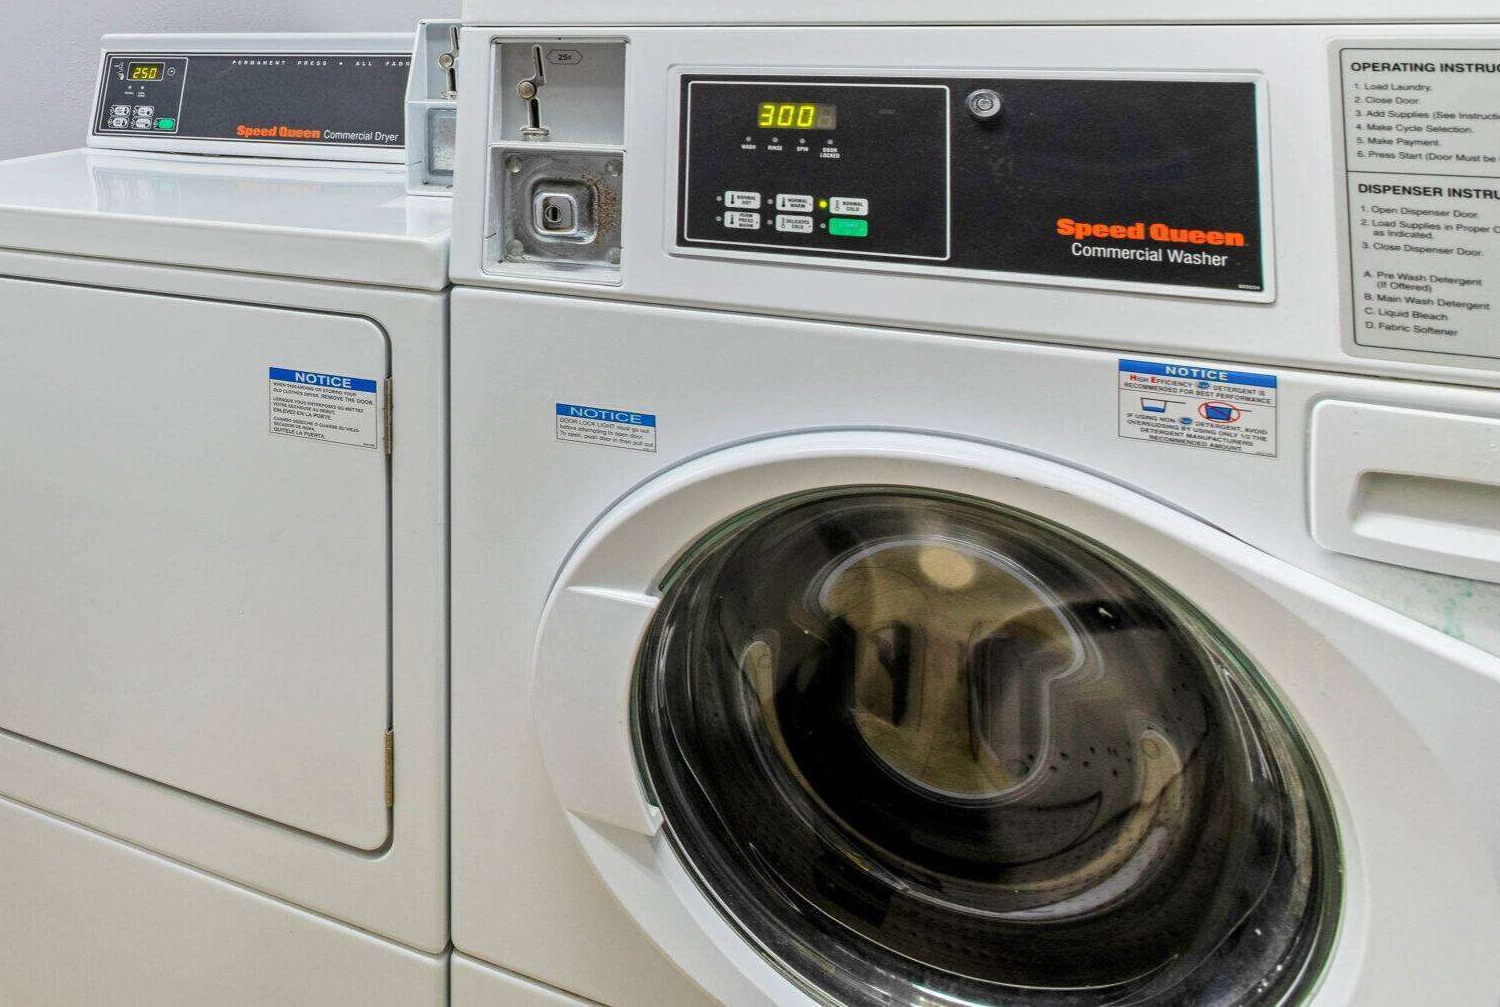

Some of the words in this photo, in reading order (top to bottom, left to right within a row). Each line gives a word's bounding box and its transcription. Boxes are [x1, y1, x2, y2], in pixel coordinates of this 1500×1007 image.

[133, 68, 157, 79] 250
[1351, 62, 1435, 73] OPERATING
[1391, 84, 1433, 92] Laundry.
[760, 105, 814, 127] 300
[1366, 110, 1385, 118] Add
[1388, 111, 1429, 119] Supplies
[1432, 112, 1456, 120] (See
[236, 125, 278, 138] Speed
[279, 126, 321, 139] Queen
[323, 130, 372, 141] Commercial
[375, 132, 398, 142] Dryer
[1367, 124, 1393, 132] Make
[1395, 125, 1422, 133] Cycle
[1426, 125, 1474, 133] Selection.
[1367, 137, 1394, 145] Make
[1368, 151, 1396, 159] Press
[1399, 152, 1422, 160] Start
[1425, 152, 1452, 161] (Door
[1456, 154, 1481, 162] Must
[1483, 154, 1496, 162] be
[1358, 184, 1443, 197] DISPENSER
[1371, 206, 1398, 215] Open
[1400, 208, 1450, 217] Dispenser
[1056, 218, 1145, 241] Speed
[1150, 223, 1245, 246] Queen
[1372, 220, 1396, 228] Load
[1399, 221, 1441, 230] Supplies
[1444, 223, 1452, 231] in
[1456, 224, 1490, 233] Proper
[1071, 243, 1163, 262] Commercial
[1167, 249, 1228, 267] Washer
[1372, 243, 1401, 252] Close
[1403, 245, 1453, 254] Dispenser
[1457, 248, 1484, 256] Door.
[1377, 272, 1394, 280] Pre
[1397, 273, 1426, 282] Wash
[1430, 275, 1482, 286] Detergent
[1390, 282, 1432, 293] Offered)
[1377, 295, 1401, 303] Main
[1404, 297, 1434, 305] Wash
[1437, 299, 1490, 311] Detergent
[1378, 308, 1409, 319] Liquid
[1412, 311, 1448, 321] Bleach
[1378, 322, 1410, 332] Fabric
[1414, 325, 1458, 336] Softener
[295, 372, 352, 388] NOTICE
[1165, 366, 1228, 381] NOTICE
[1124, 382, 1177, 393] RECOMMENDED
[1196, 390, 1214, 398] BEST
[1216, 393, 1271, 404] PERFORMANCE
[1213, 385, 1257, 395] DETERGENT
[570, 407, 642, 424] NOTICE
[1136, 414, 1158, 422] USING
[1140, 428, 1184, 437] DETERGENT
[1149, 435, 1208, 447] RECOMMENDED
